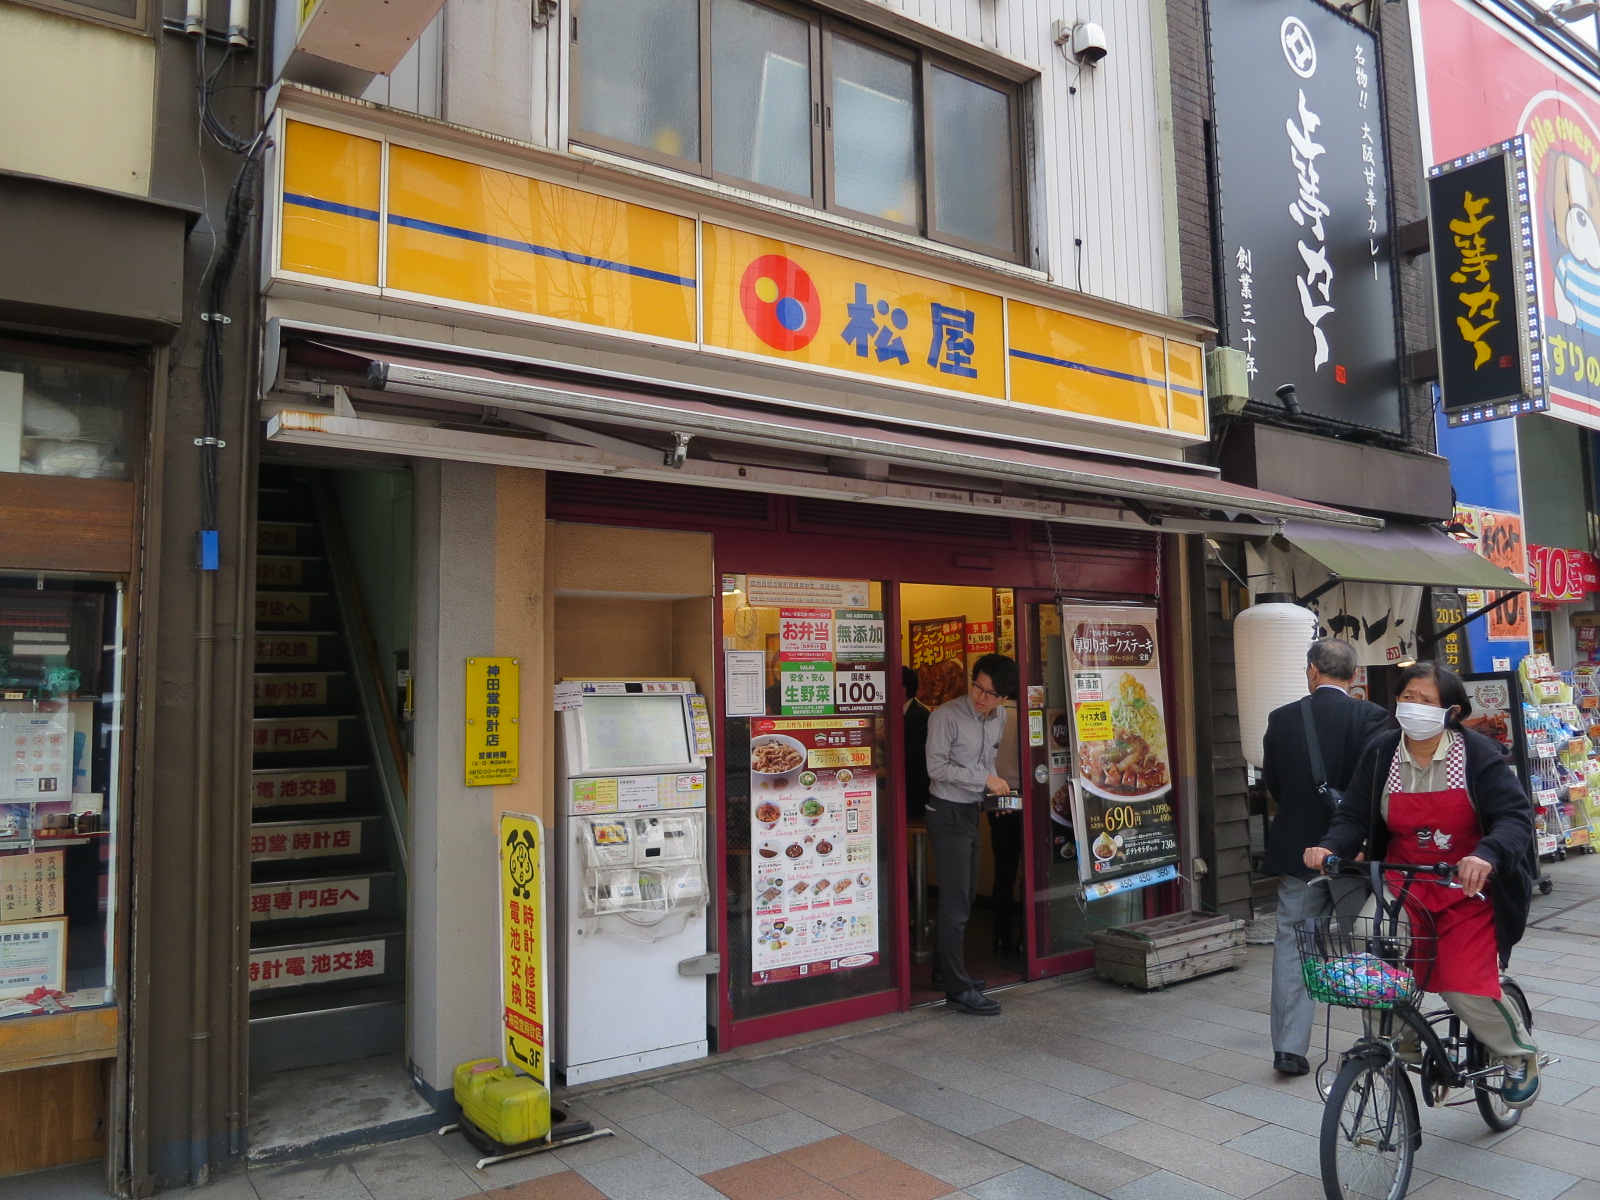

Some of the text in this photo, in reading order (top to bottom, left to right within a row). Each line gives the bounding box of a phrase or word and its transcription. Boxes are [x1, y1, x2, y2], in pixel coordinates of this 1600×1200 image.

[1360, 121, 1380, 283] 大阪甘辛カレー
[1236, 247, 1259, 382] 創業三十年
[841, 282, 978, 380] 松屋
[1547, 334, 1600, 388] すりの
[1436, 608, 1462, 624] 2015
[783, 621, 829, 641] お弁当
[837, 624, 883, 644] 無添加
[913, 631, 945, 650] ごろごろ
[1074, 636, 1154, 654] 厚切りポークステーキ
[1444, 632, 1460, 673] 神田カ
[913, 646, 963, 670] チキン カレー
[790, 673, 825, 682] 安全・安心
[851, 673, 871, 682] 国産米
[1077, 679, 1099, 690] 無添加
[785, 685, 830, 703] 生野菜
[838, 682, 884, 703] 100%
[486, 664, 501, 747] 神田堂時計店
[1080, 711, 1107, 721] ライス大盛
[478, 751, 507, 759] 営業時間
[509, 900, 522, 1008] 電池交換
[528, 1047, 541, 1068] 3F
